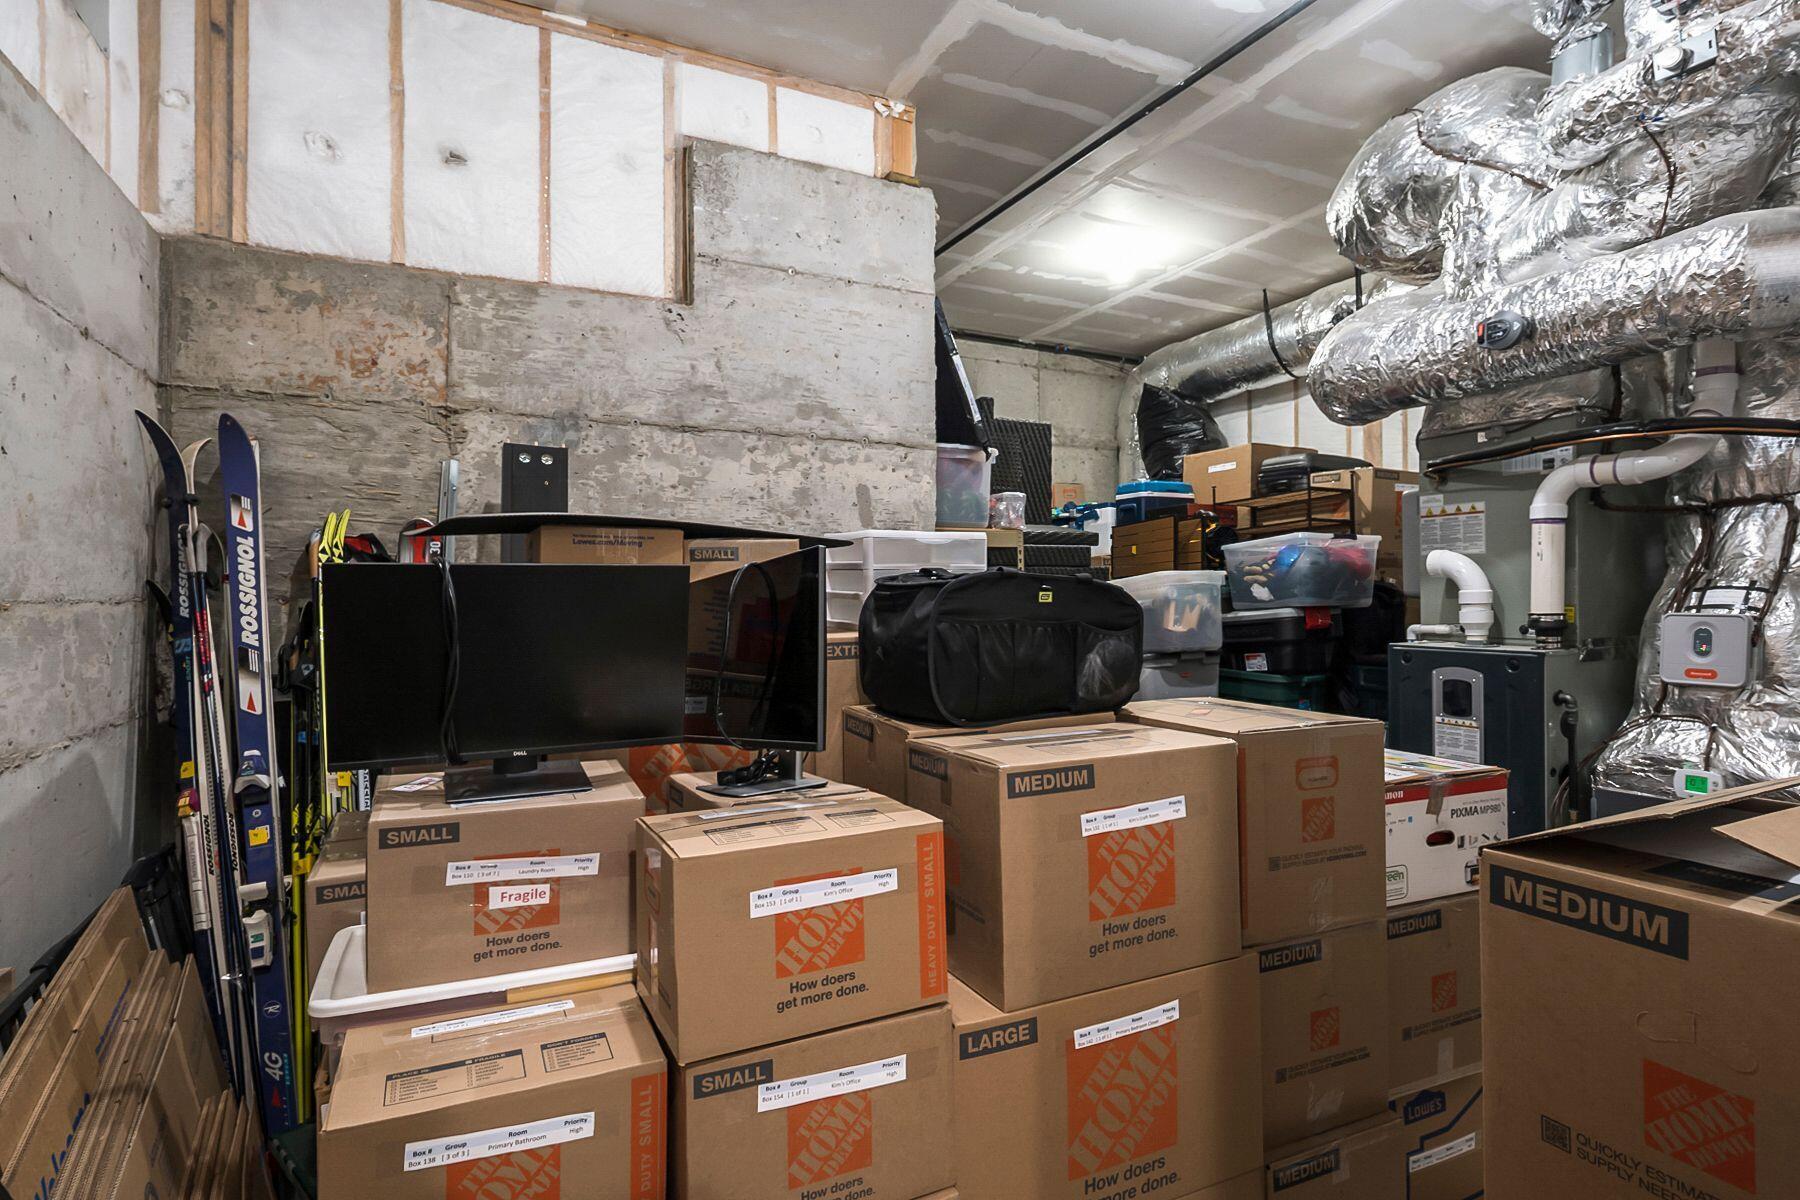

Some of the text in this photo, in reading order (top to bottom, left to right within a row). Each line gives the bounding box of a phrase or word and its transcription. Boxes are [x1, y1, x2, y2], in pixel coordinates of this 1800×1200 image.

[694, 549, 735, 559] SMALL
[236, 535, 260, 647] ROSSIGNOL
[827, 645, 860, 657] EXTR
[911, 752, 945, 774] MEDIUM
[1014, 769, 1089, 794] MEDIUM
[1450, 805, 1479, 818] PIXMA
[203, 814, 215, 876] ROSSIGNOL
[226, 812, 239, 872] ROSSIGNOL
[386, 826, 453, 846] SMALL
[578, 864, 590, 872] High
[500, 888, 547, 903] Fragile
[782, 888, 799, 896] Group
[874, 872, 892, 880] Priority
[838, 887, 853, 895] Office
[878, 880, 890, 888] High
[925, 842, 937, 988] HEAVY DUTY SMALL
[1503, 875, 1669, 945] MEDIUM
[1102, 913, 1166, 937] How doers
[1389, 914, 1438, 936] MEDIUM
[473, 940, 562, 962] get more done.
[486, 931, 550, 948] How doers
[1089, 926, 1178, 958] get more done.
[1261, 944, 1318, 969] MEDIUM
[789, 971, 856, 994] How doers
[776, 982, 870, 1014] get more done.
[967, 1023, 1030, 1053] LARGE
[263, 1052, 284, 1081] 4G
[701, 1065, 766, 1093] SMALL
[790, 1080, 808, 1088] Group
[882, 1060, 900, 1068] Priority
[846, 1078, 862, 1086] Office
[886, 1070, 898, 1078] High
[1646, 1093, 1750, 1152] HOME
[408, 1160, 422, 1168] Box
[488, 1141, 513, 1151] Primary
[515, 1134, 547, 1146] Bathroom
[570, 1126, 584, 1135] High
[412, 1149, 427, 1158] Box
[445, 1142, 468, 1152] Group
[508, 1130, 528, 1138] Room
[564, 1117, 588, 1127] Priority
[640, 1085, 651, 1192] DUTY SMALL
[1576, 1132, 1642, 1171] QUICKLY
[1576, 1147, 1634, 1182] SUPPLY
[1084, 1156, 1166, 1195] How doers
[1141, 1171, 1182, 1194] done.
[1279, 1155, 1336, 1187] MEDIUM
[801, 1186, 828, 1200] How
[831, 1177, 864, 1194] doers
